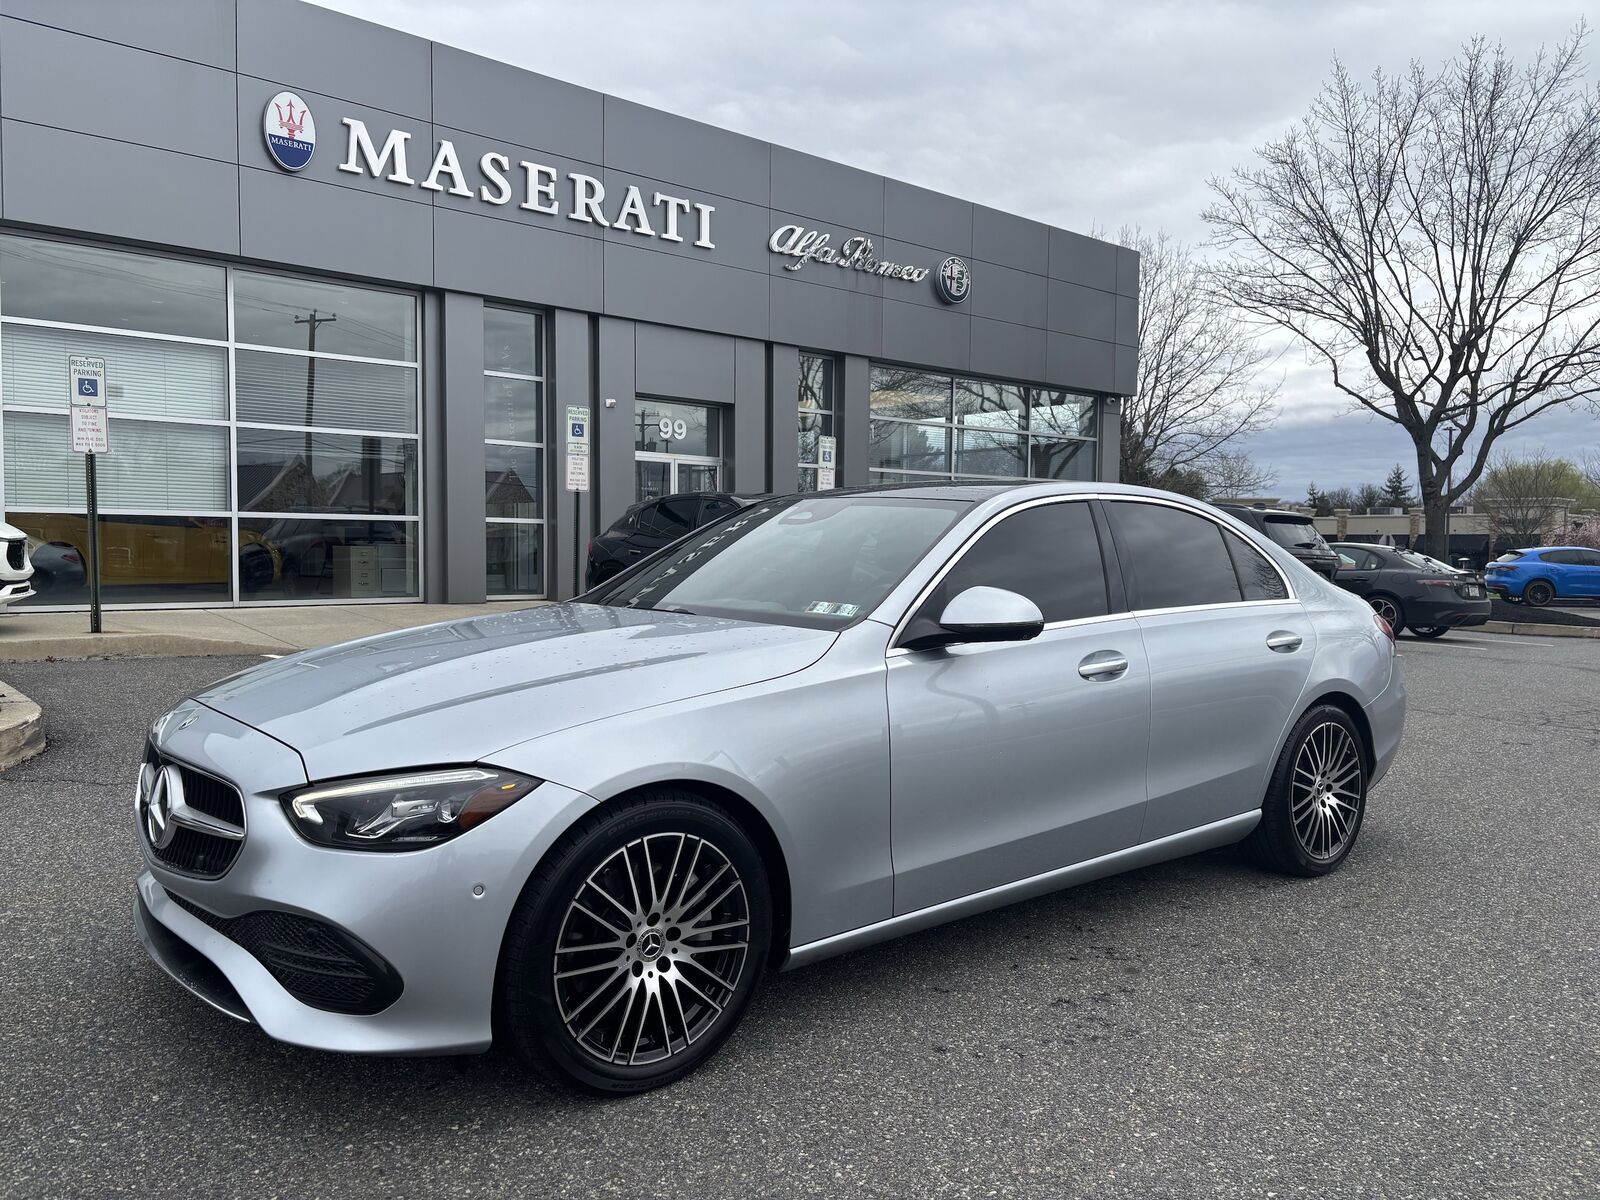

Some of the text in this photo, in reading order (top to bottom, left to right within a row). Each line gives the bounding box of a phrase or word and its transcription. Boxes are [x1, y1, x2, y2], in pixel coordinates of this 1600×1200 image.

[271, 136, 311, 151] MASERATI
[338, 116, 716, 249] MASERATI
[768, 224, 930, 283] Alfa Romeo
[71, 360, 104, 369] RESERVED
[73, 369, 102, 377] PARKING
[660, 418, 687, 440] 99
